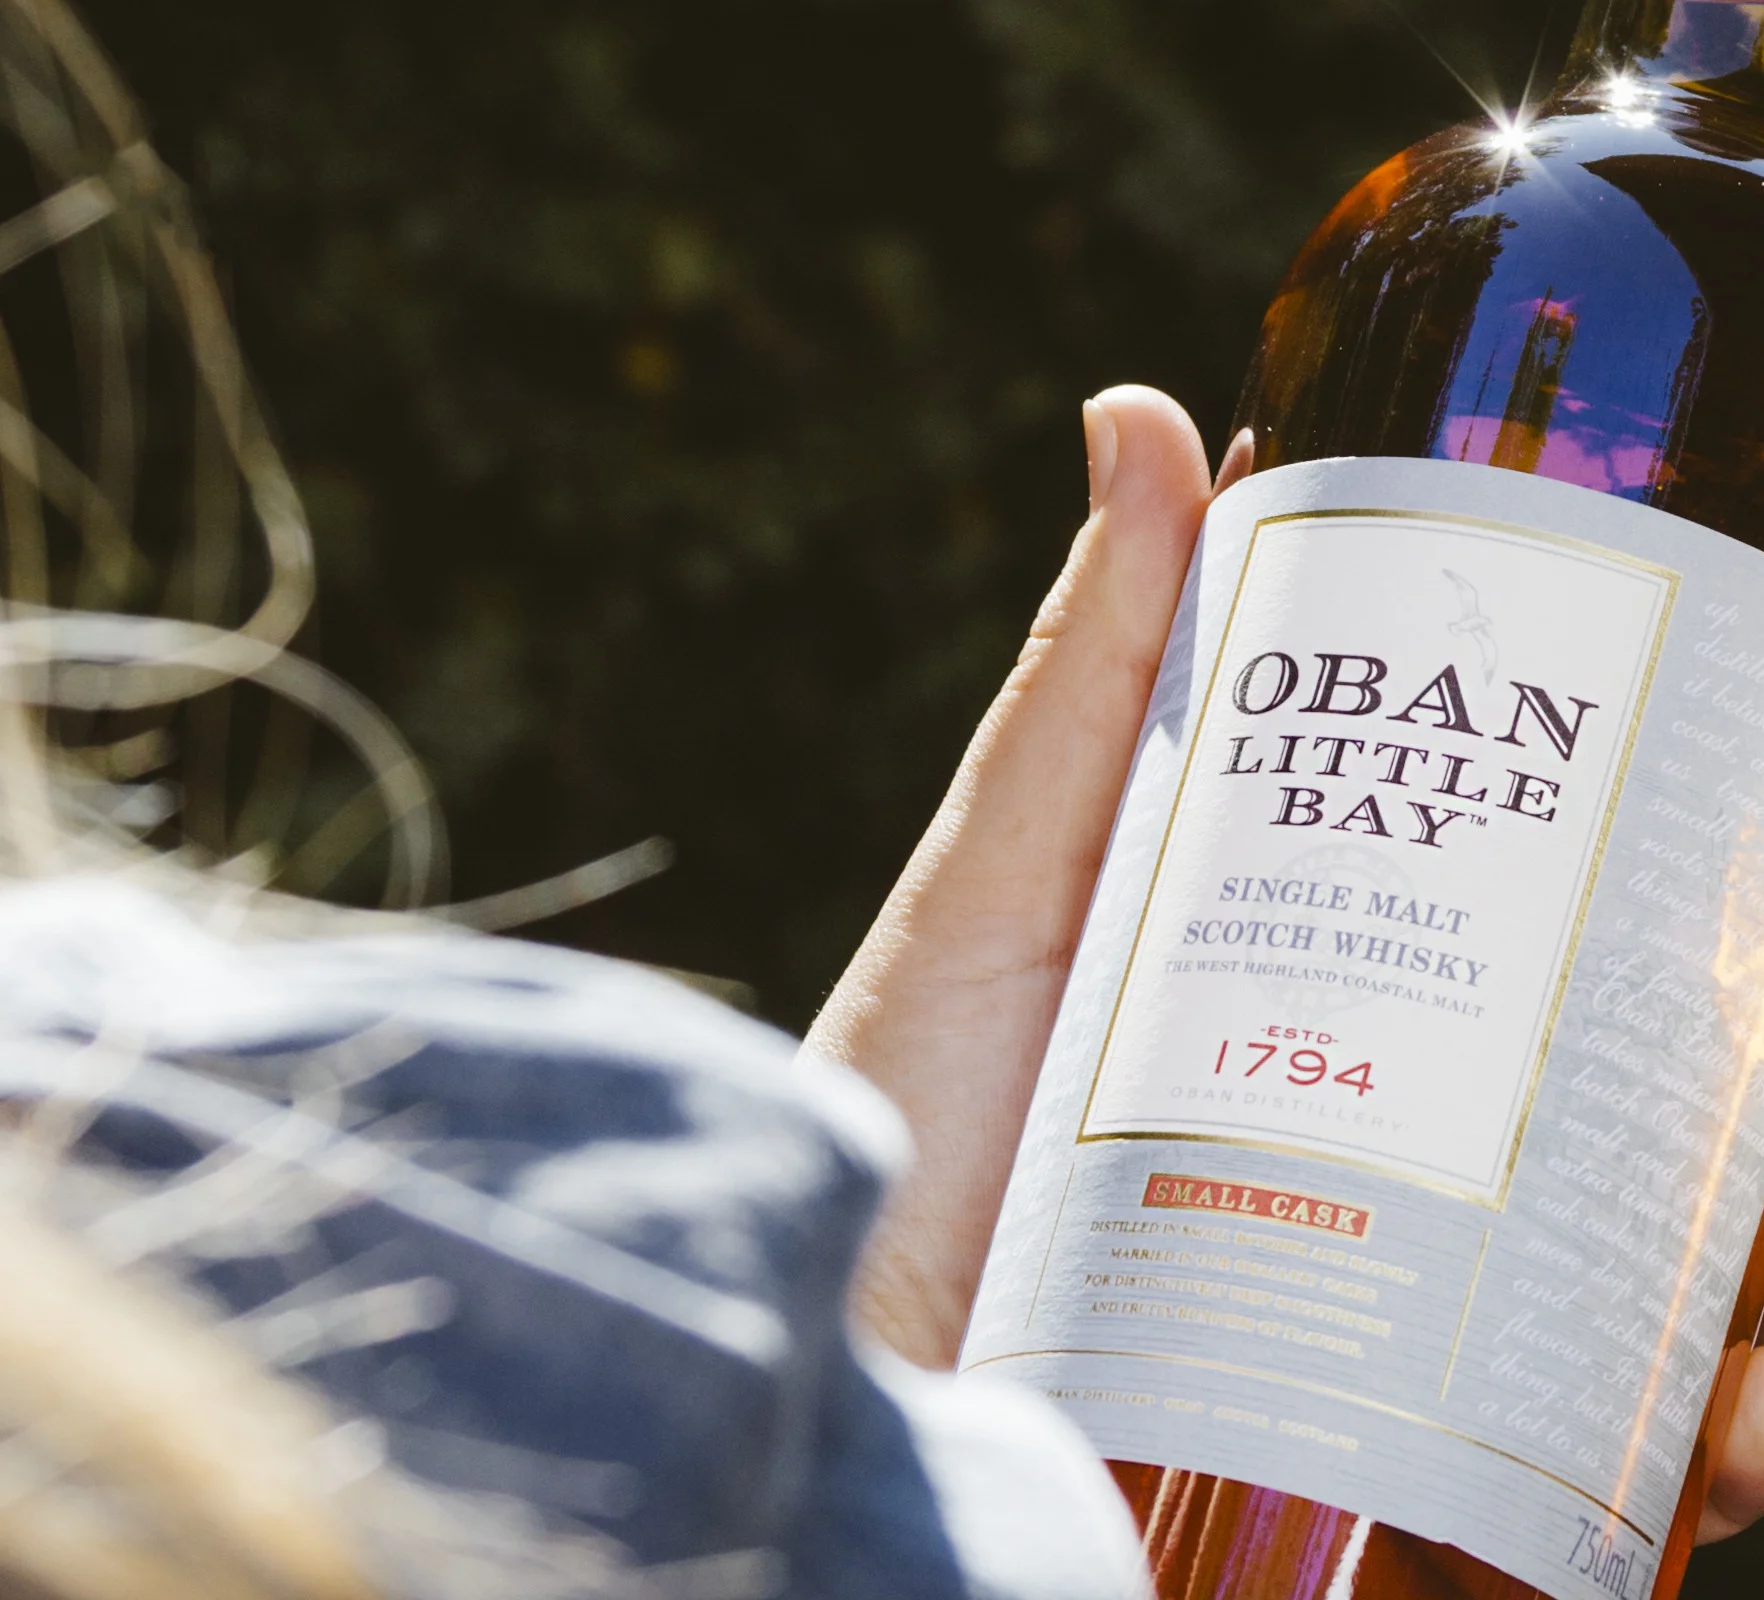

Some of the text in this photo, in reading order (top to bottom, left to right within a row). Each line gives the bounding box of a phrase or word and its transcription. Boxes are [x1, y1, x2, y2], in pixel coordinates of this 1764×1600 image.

[1232, 651, 1600, 763] OBAN
[1681, 674, 1712, 700] it
[1219, 736, 1562, 823] LITTLE
[1218, 876, 1470, 936] SINGLE MALT
[1627, 870, 1704, 926] things
[1183, 919, 1489, 988] SCOTCH WHISKY
[1164, 960, 1486, 1020] THE WEST HIGHLAND COASTAL MALT
[1214, 1039, 1375, 1098] 1794
[1582, 1027, 1646, 1073] takes
[1570, 1064, 1645, 1116] batch
[1560, 1116, 1689, 1182] malt and
[1153, 1181, 1360, 1233] SMALL CASK
[1547, 1155, 1666, 1225] extra time
[1090, 1220, 1159, 1234] DISTILLED
[1163, 1224, 1176, 1234] IN
[1085, 1274, 1111, 1287] FOR
[1110, 1248, 1174, 1262] MARRIED
[1090, 1301, 1118, 1314] AND
[1505, 1400, 1549, 1439] lot
[1546, 1424, 1573, 1451] to
[1574, 1384, 1614, 1426] but
